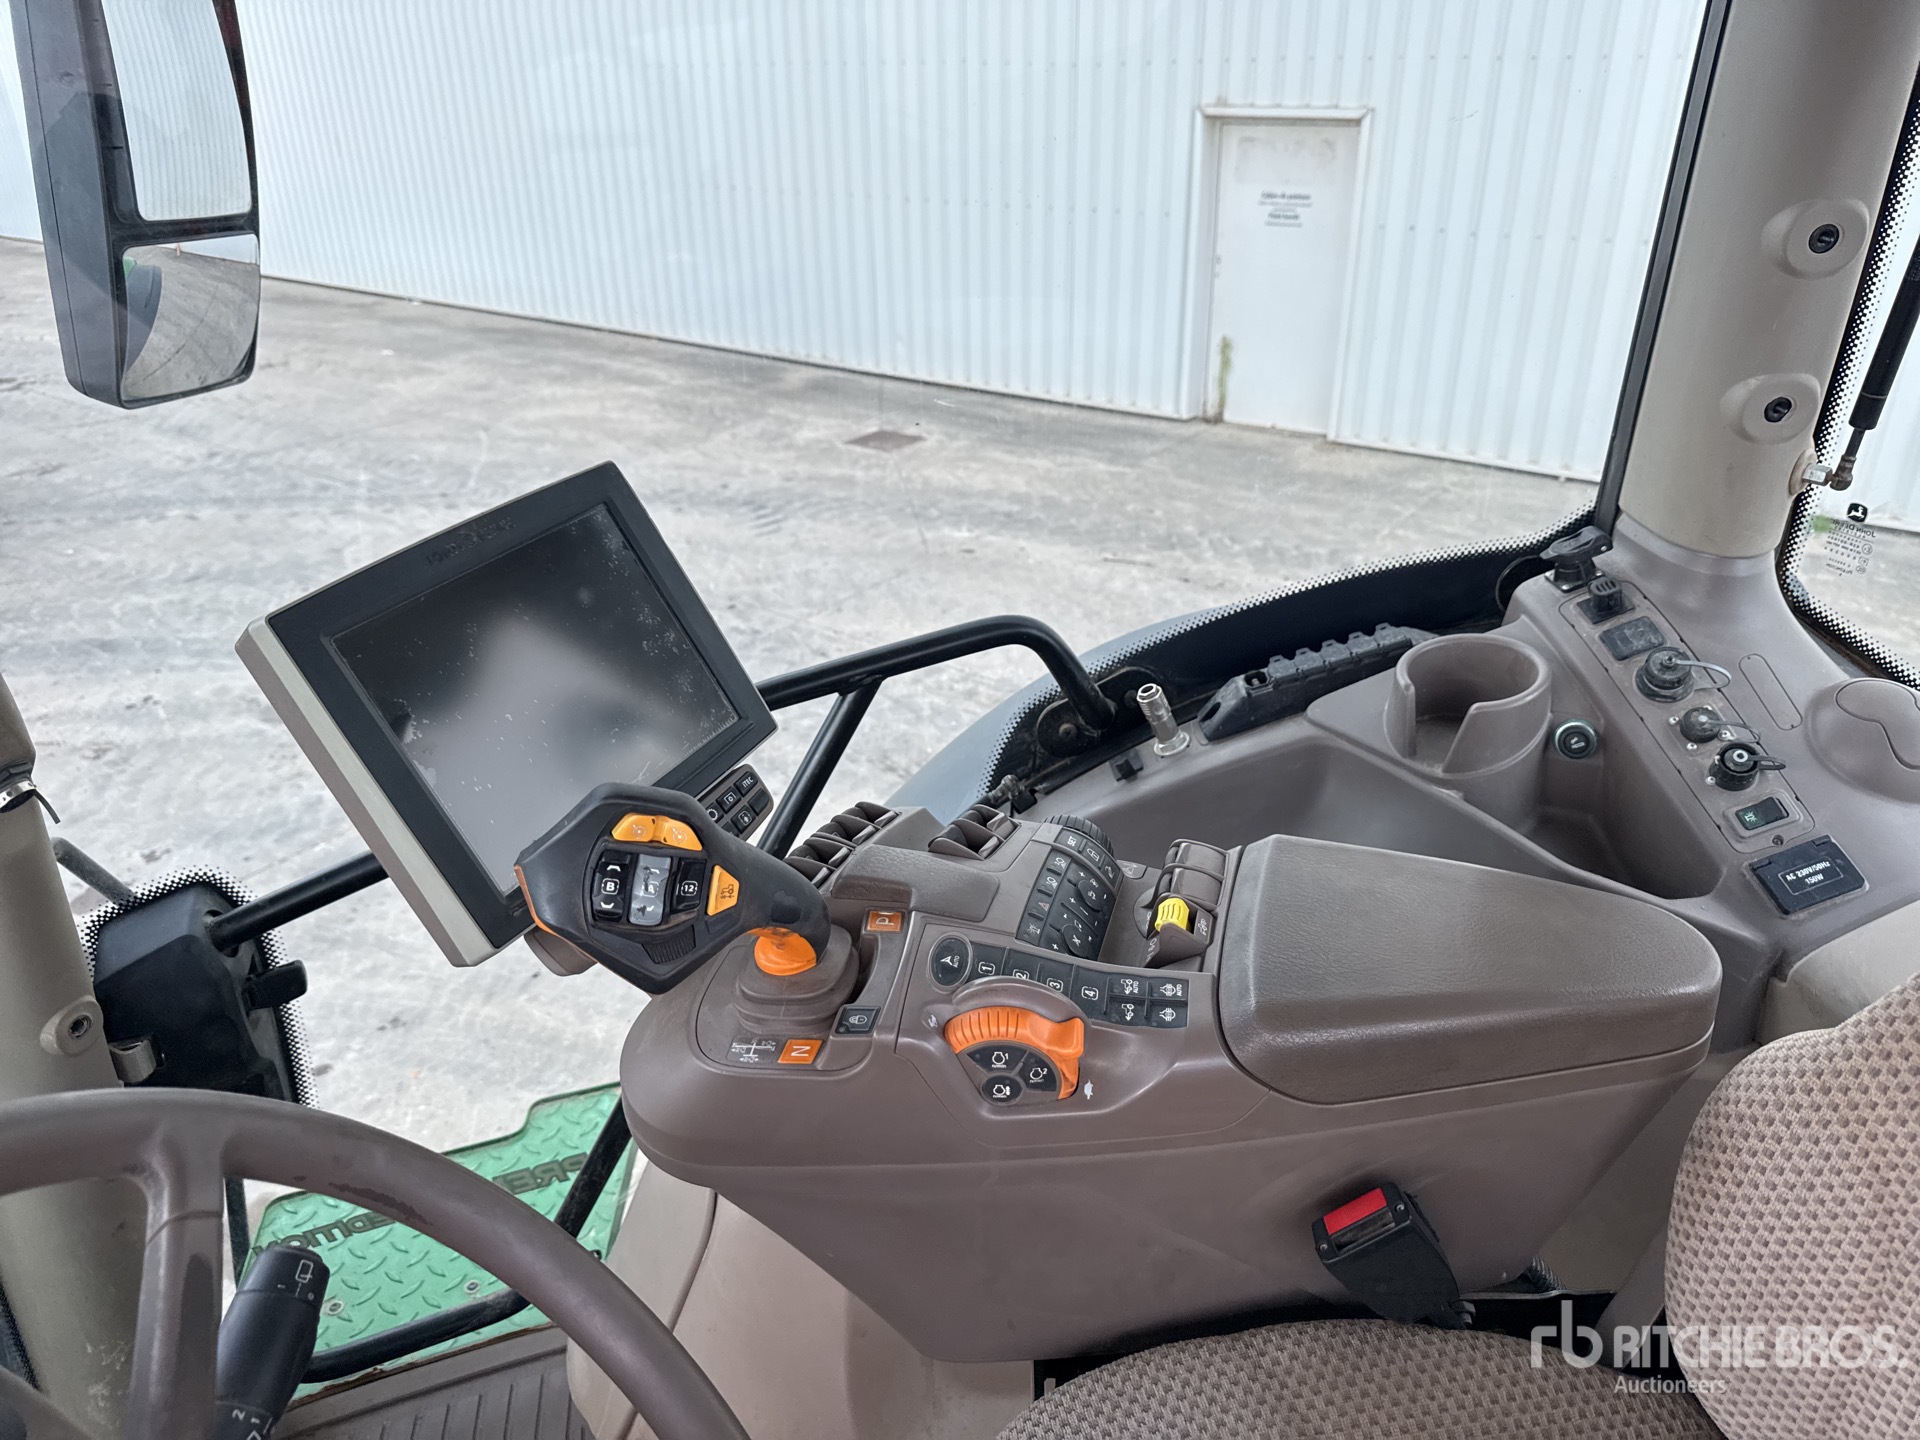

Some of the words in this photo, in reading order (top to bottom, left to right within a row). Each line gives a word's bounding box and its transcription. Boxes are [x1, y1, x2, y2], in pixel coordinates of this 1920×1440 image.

[1785, 873, 1796, 881] AC
[1795, 861, 1831, 878] 230V/50Hz
[1804, 873, 1824, 885] 150W
[684, 884, 694, 892] 12
[1049, 981, 1060, 989] 3
[1084, 989, 1095, 997] 4
[791, 1045, 811, 1056] N
